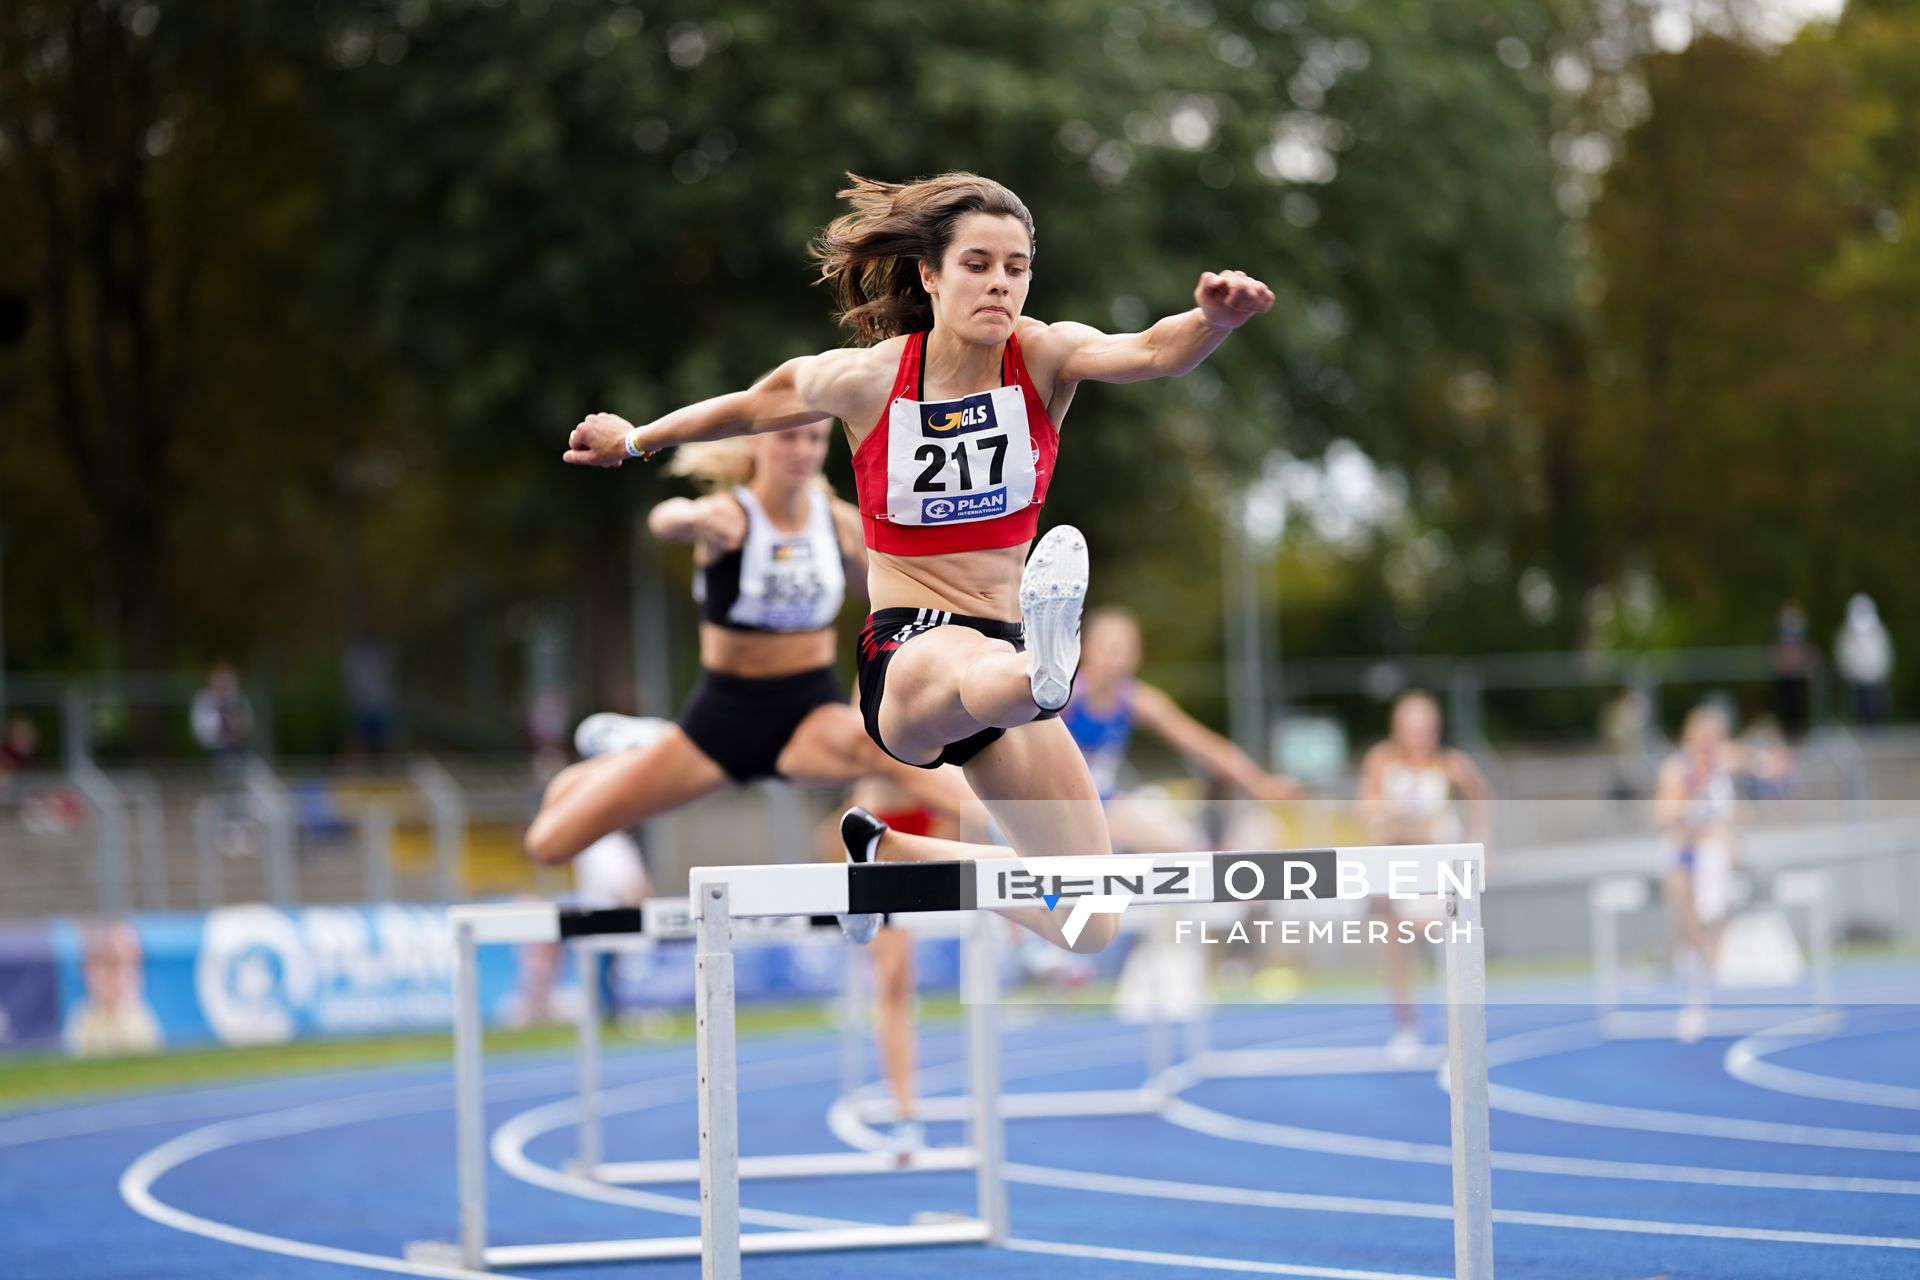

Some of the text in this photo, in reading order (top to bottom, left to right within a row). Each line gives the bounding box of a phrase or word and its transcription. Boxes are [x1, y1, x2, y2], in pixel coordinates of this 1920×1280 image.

[961, 405, 988, 428] GLS
[913, 434, 1009, 493] 217
[957, 494, 1004, 511] PLAN
[957, 507, 1004, 517] INTERNATIONAL
[998, 866, 1189, 899] BENZ
